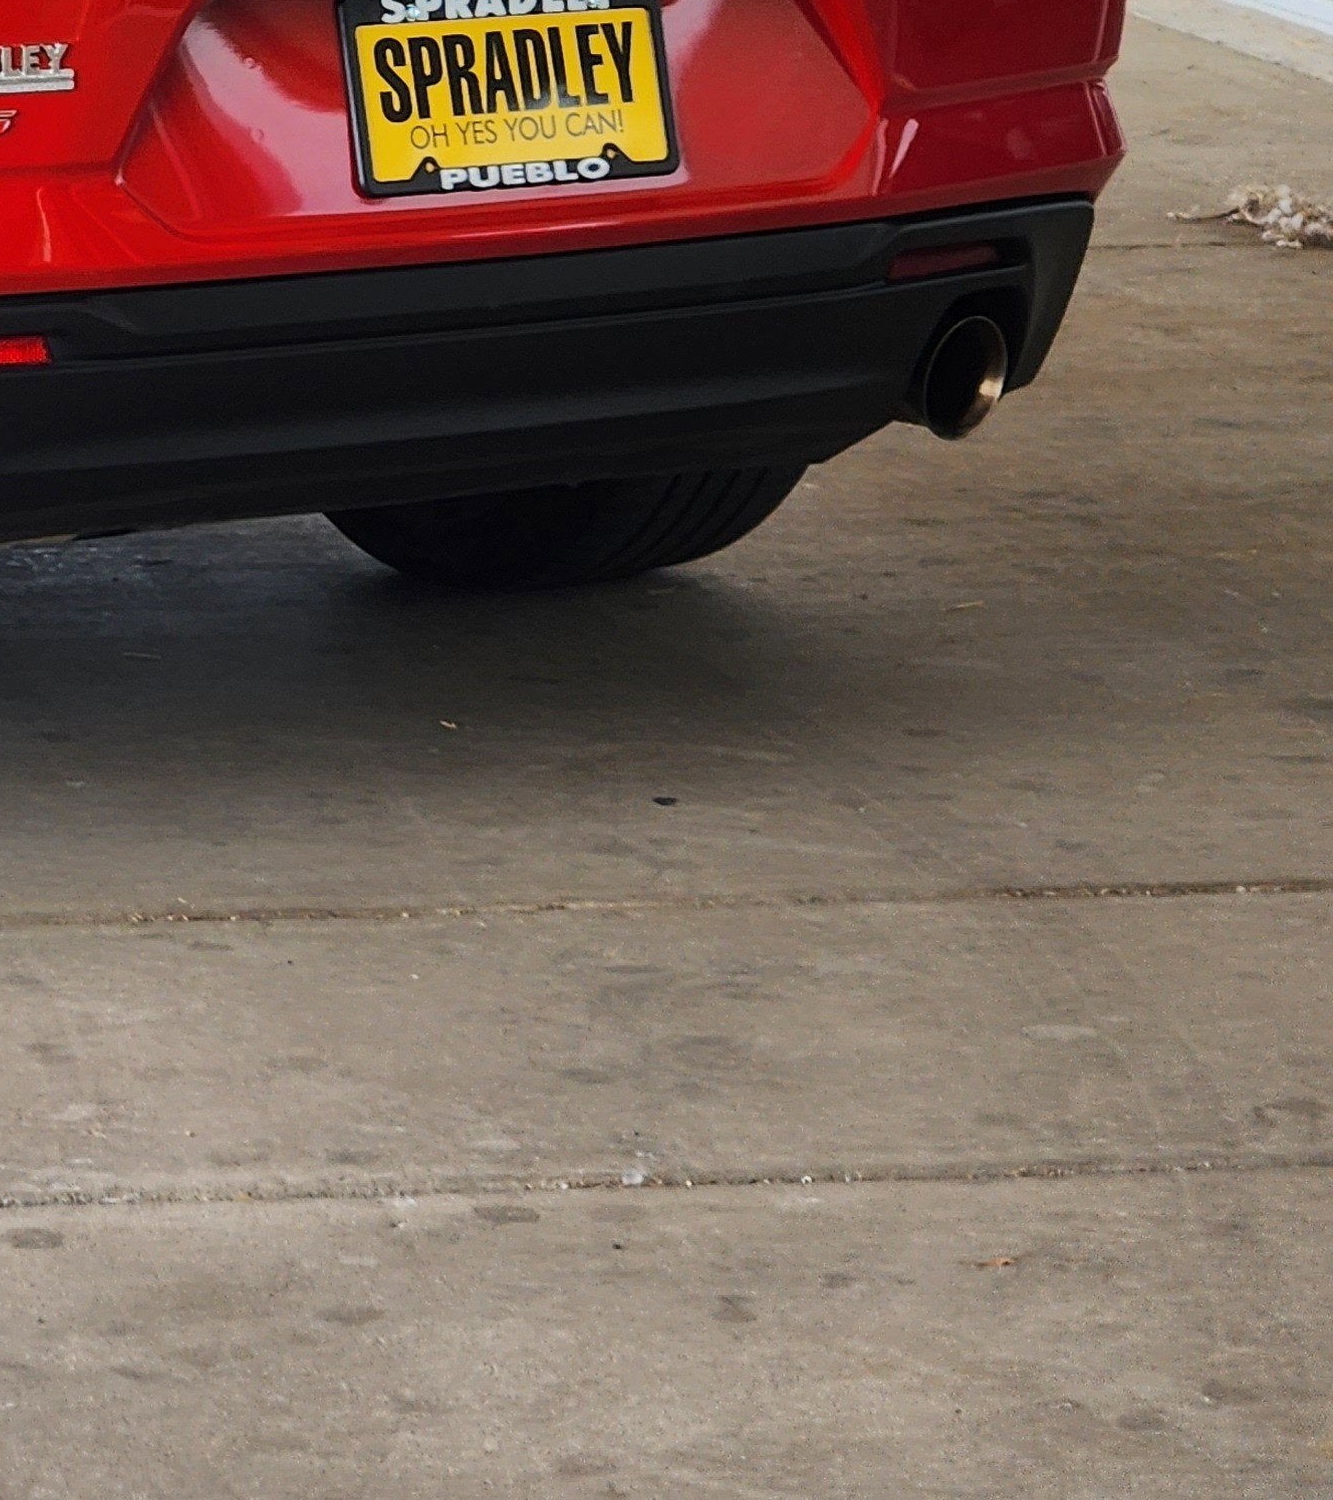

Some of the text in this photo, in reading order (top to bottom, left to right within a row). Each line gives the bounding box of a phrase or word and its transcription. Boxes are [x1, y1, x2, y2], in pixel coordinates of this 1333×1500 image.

[374, 21, 634, 123] SPRADLEY
[410, 109, 624, 150] OH YES YOU CAN!
[440, 156, 611, 190] PUEBLO
